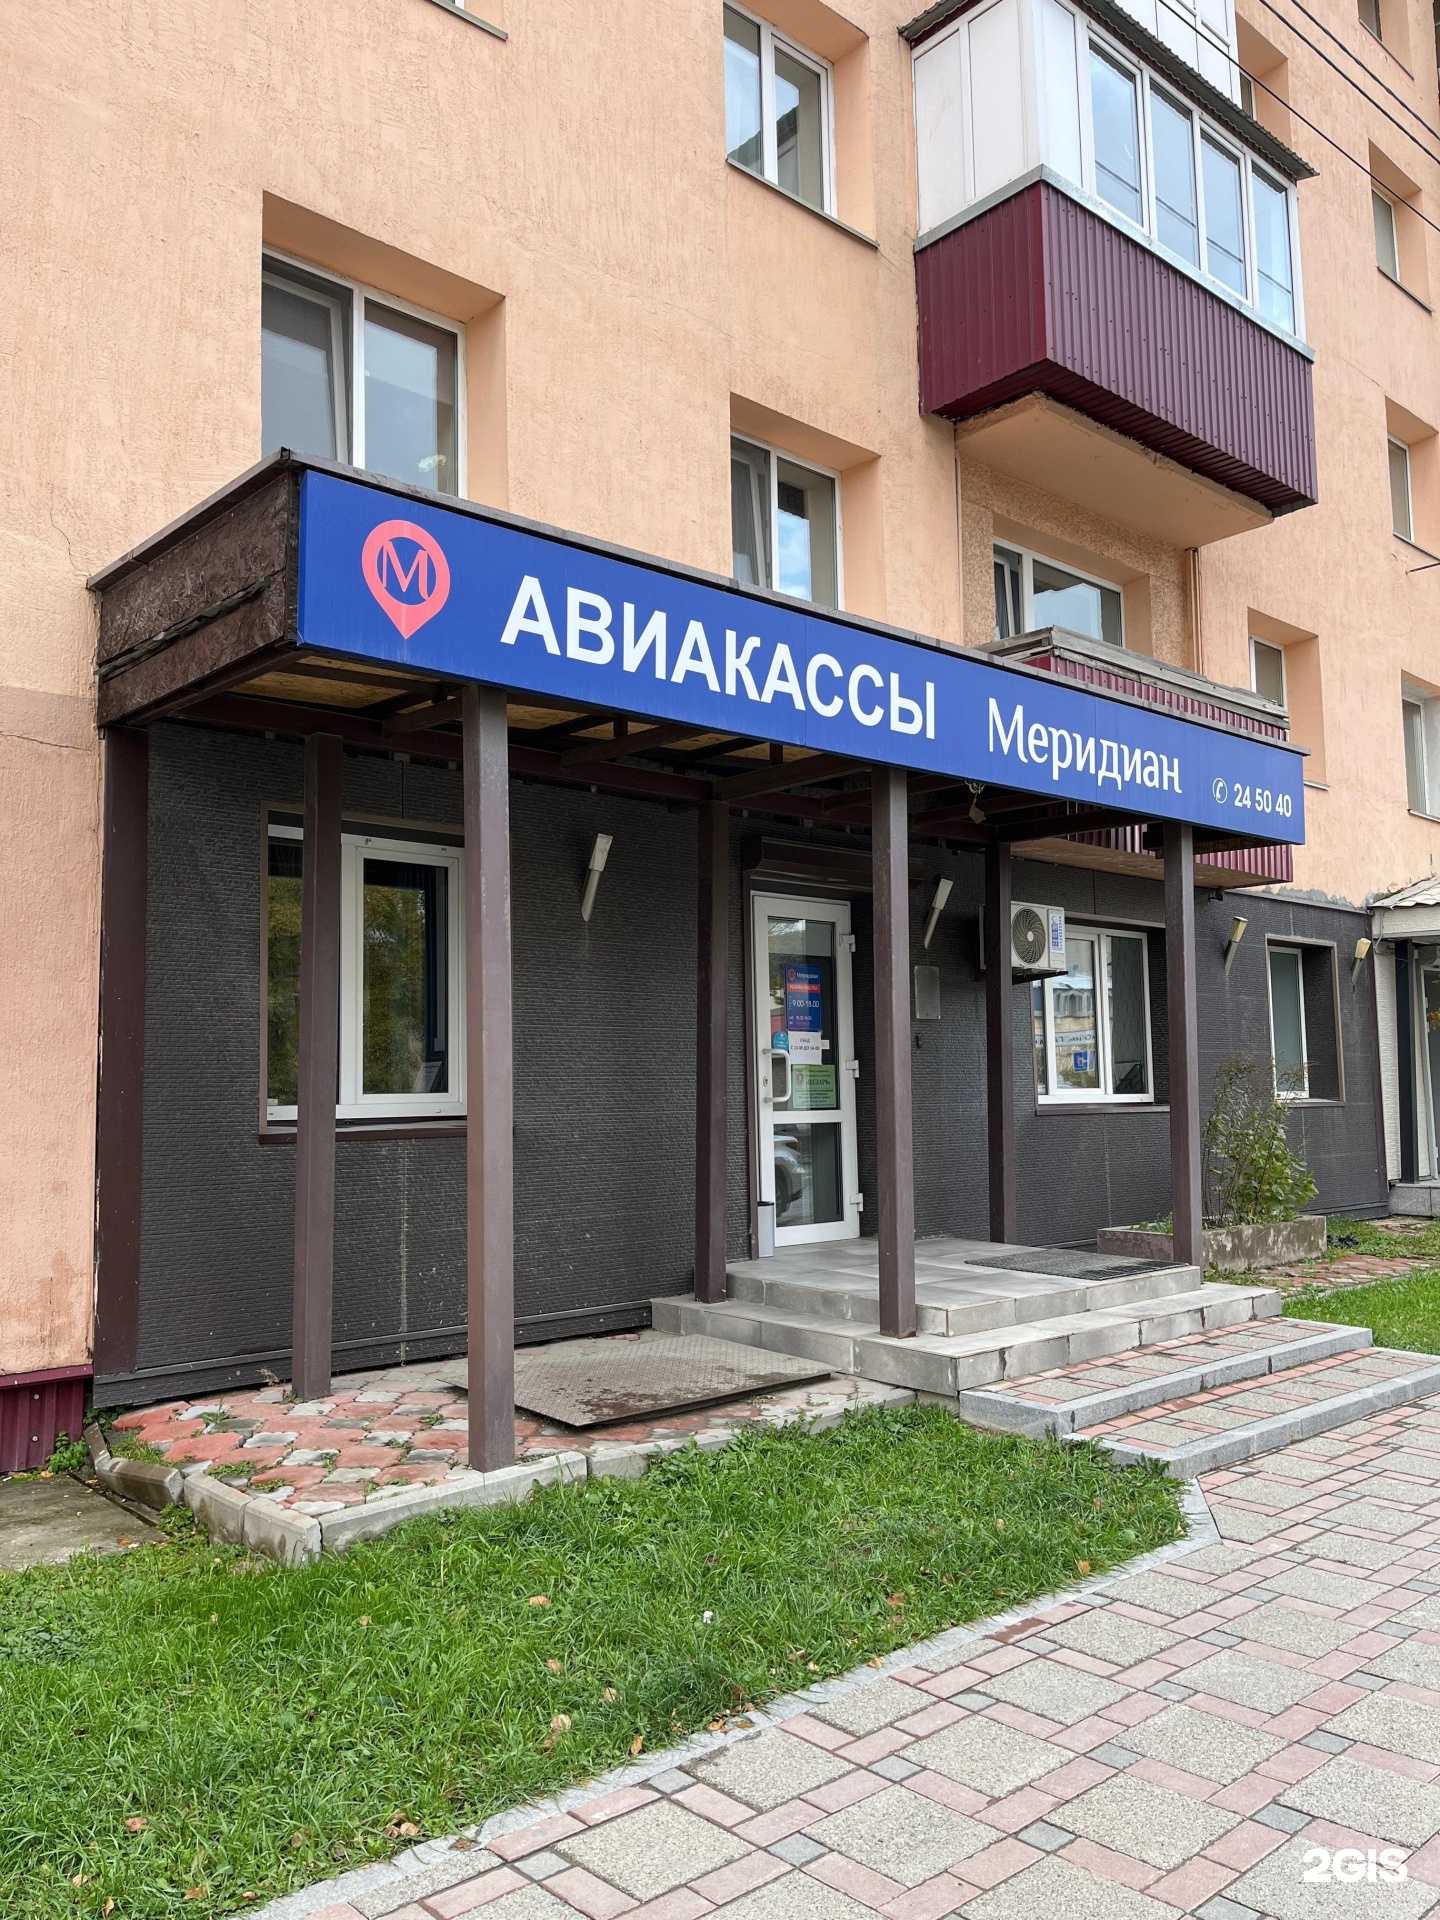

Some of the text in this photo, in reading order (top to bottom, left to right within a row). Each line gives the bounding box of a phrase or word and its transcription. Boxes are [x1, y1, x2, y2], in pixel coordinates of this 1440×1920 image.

[500, 575, 936, 741] АВИАКАССЫ
[988, 697, 1183, 794] Меридиан
[1233, 783, 1292, 817] 24 50 40
